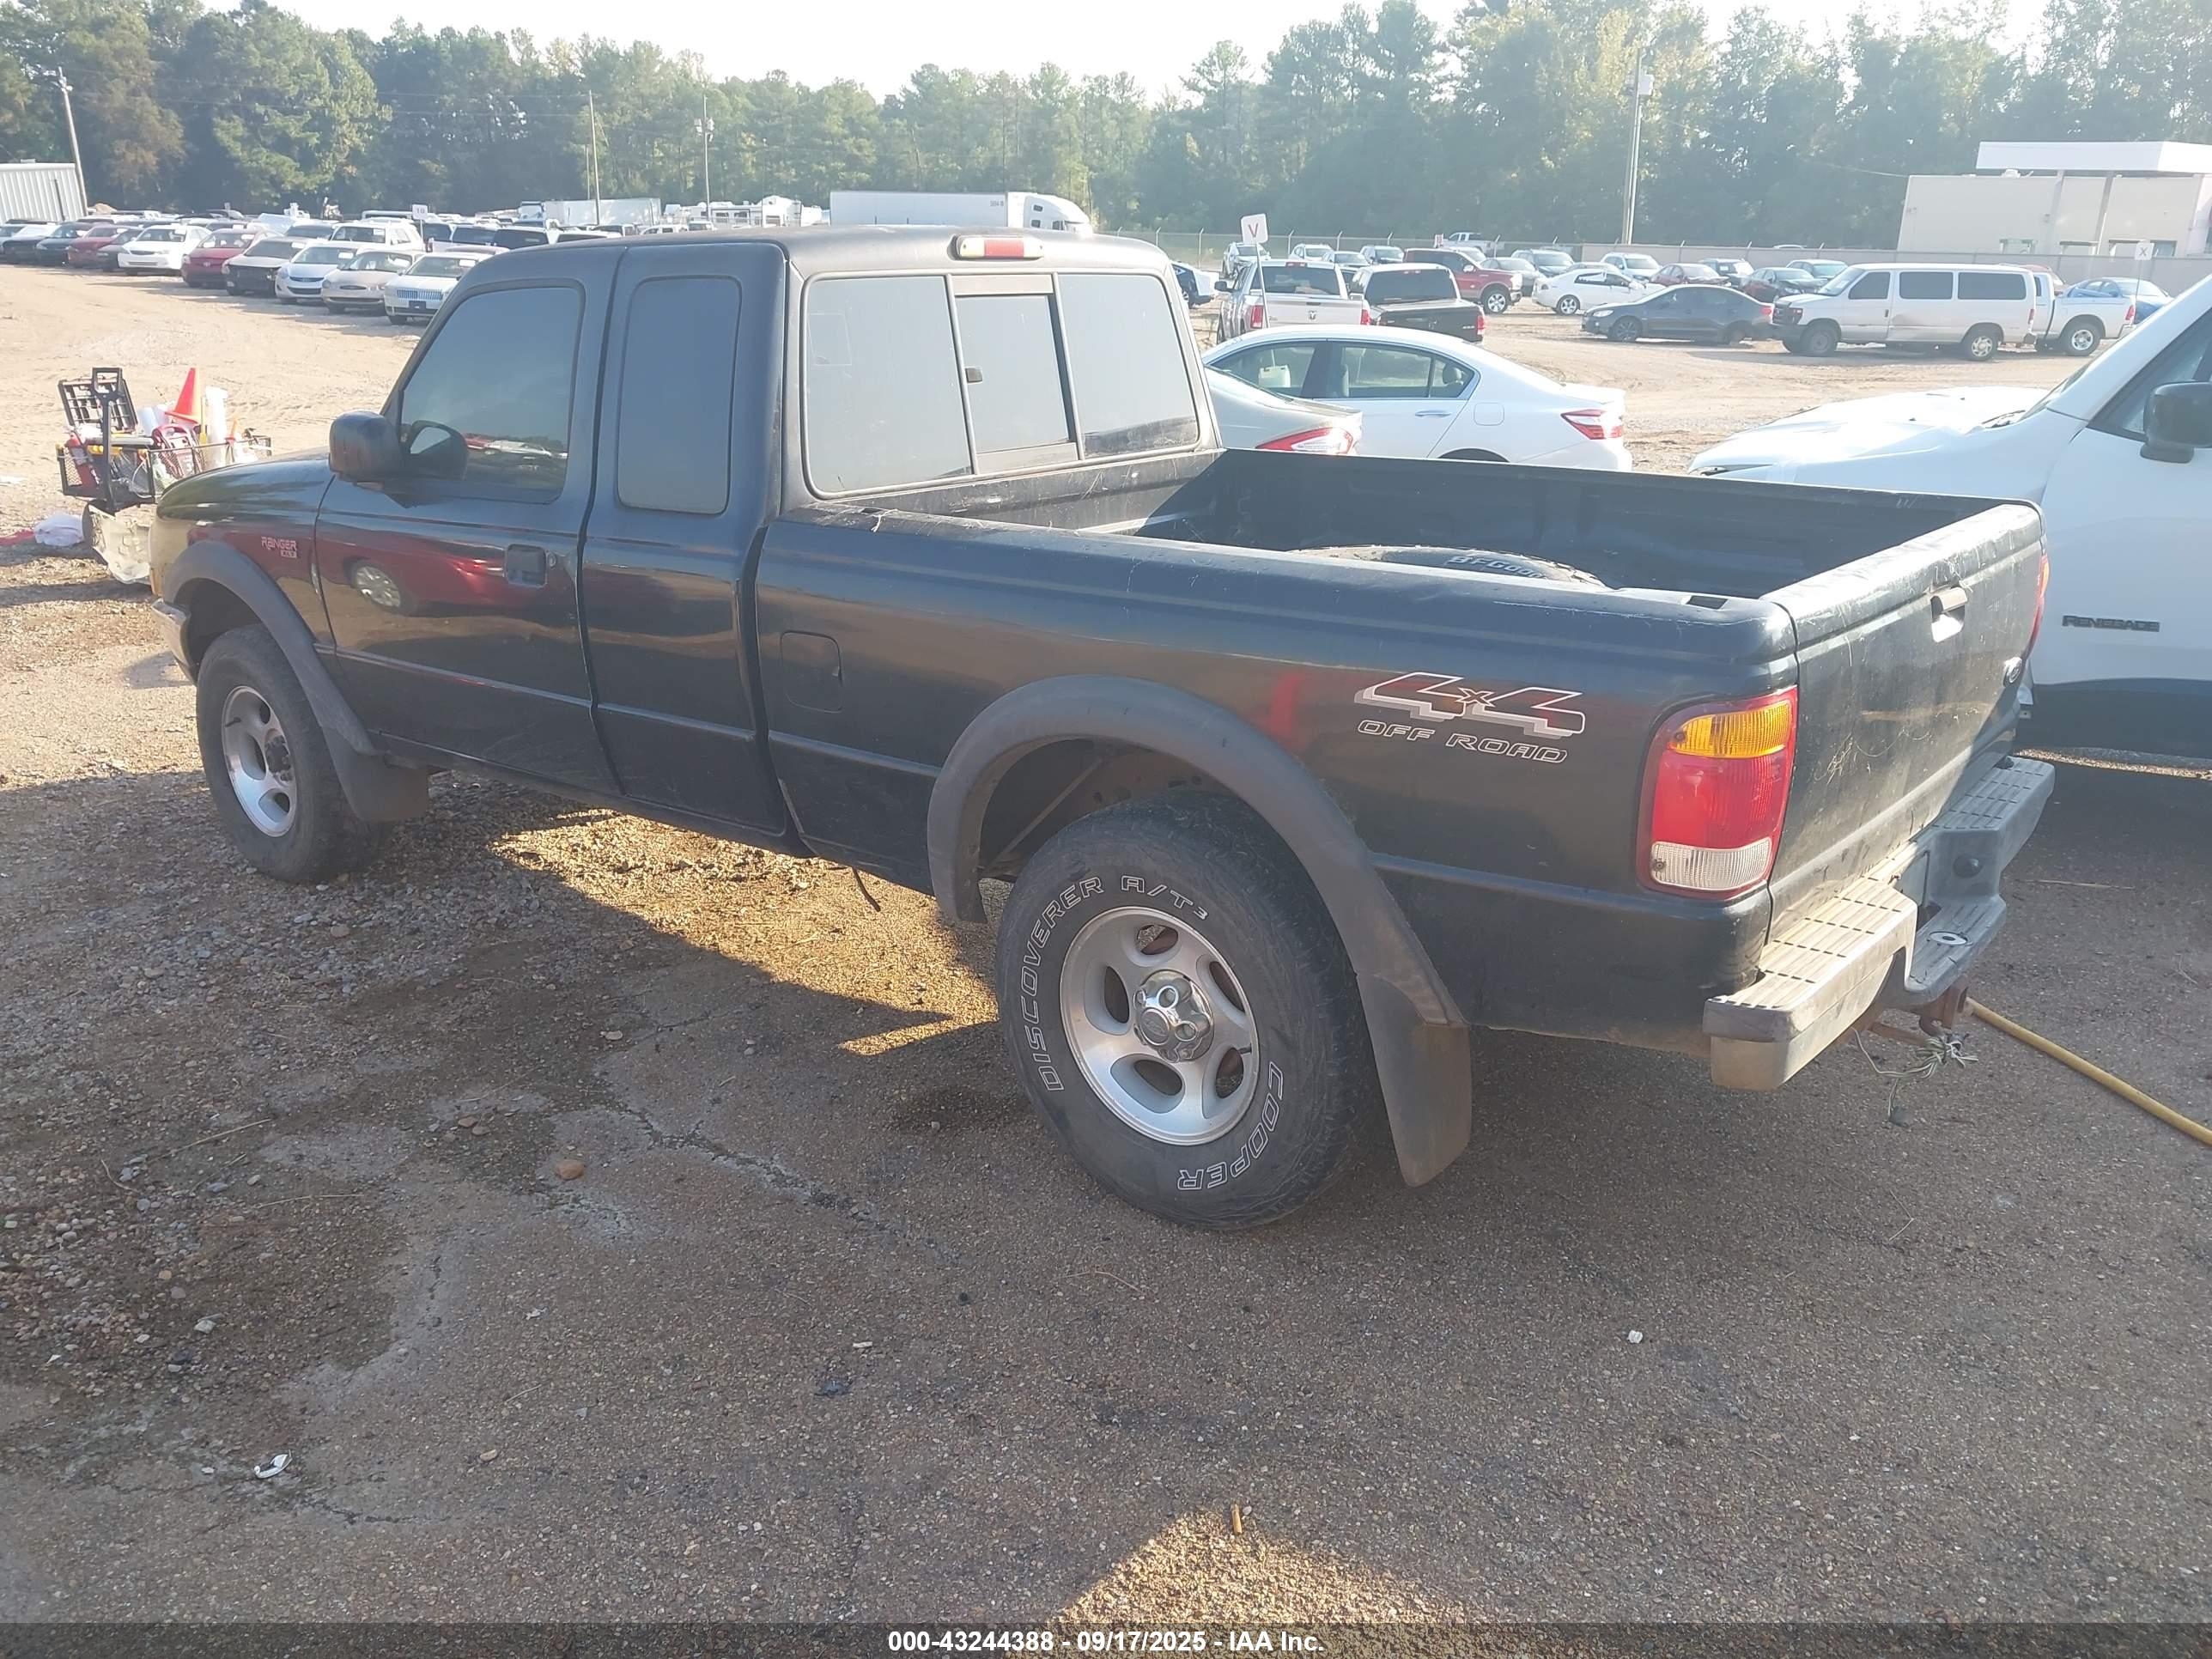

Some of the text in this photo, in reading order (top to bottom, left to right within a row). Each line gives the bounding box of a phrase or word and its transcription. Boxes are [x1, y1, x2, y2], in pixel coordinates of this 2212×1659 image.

[1248, 222, 1259, 238] V
[2138, 247, 2148, 257] X
[1358, 720, 1568, 763] OFF ROAD
[1019, 876, 1104, 1092] DISCOVERER
[1176, 1060, 1285, 1191] COOPER
